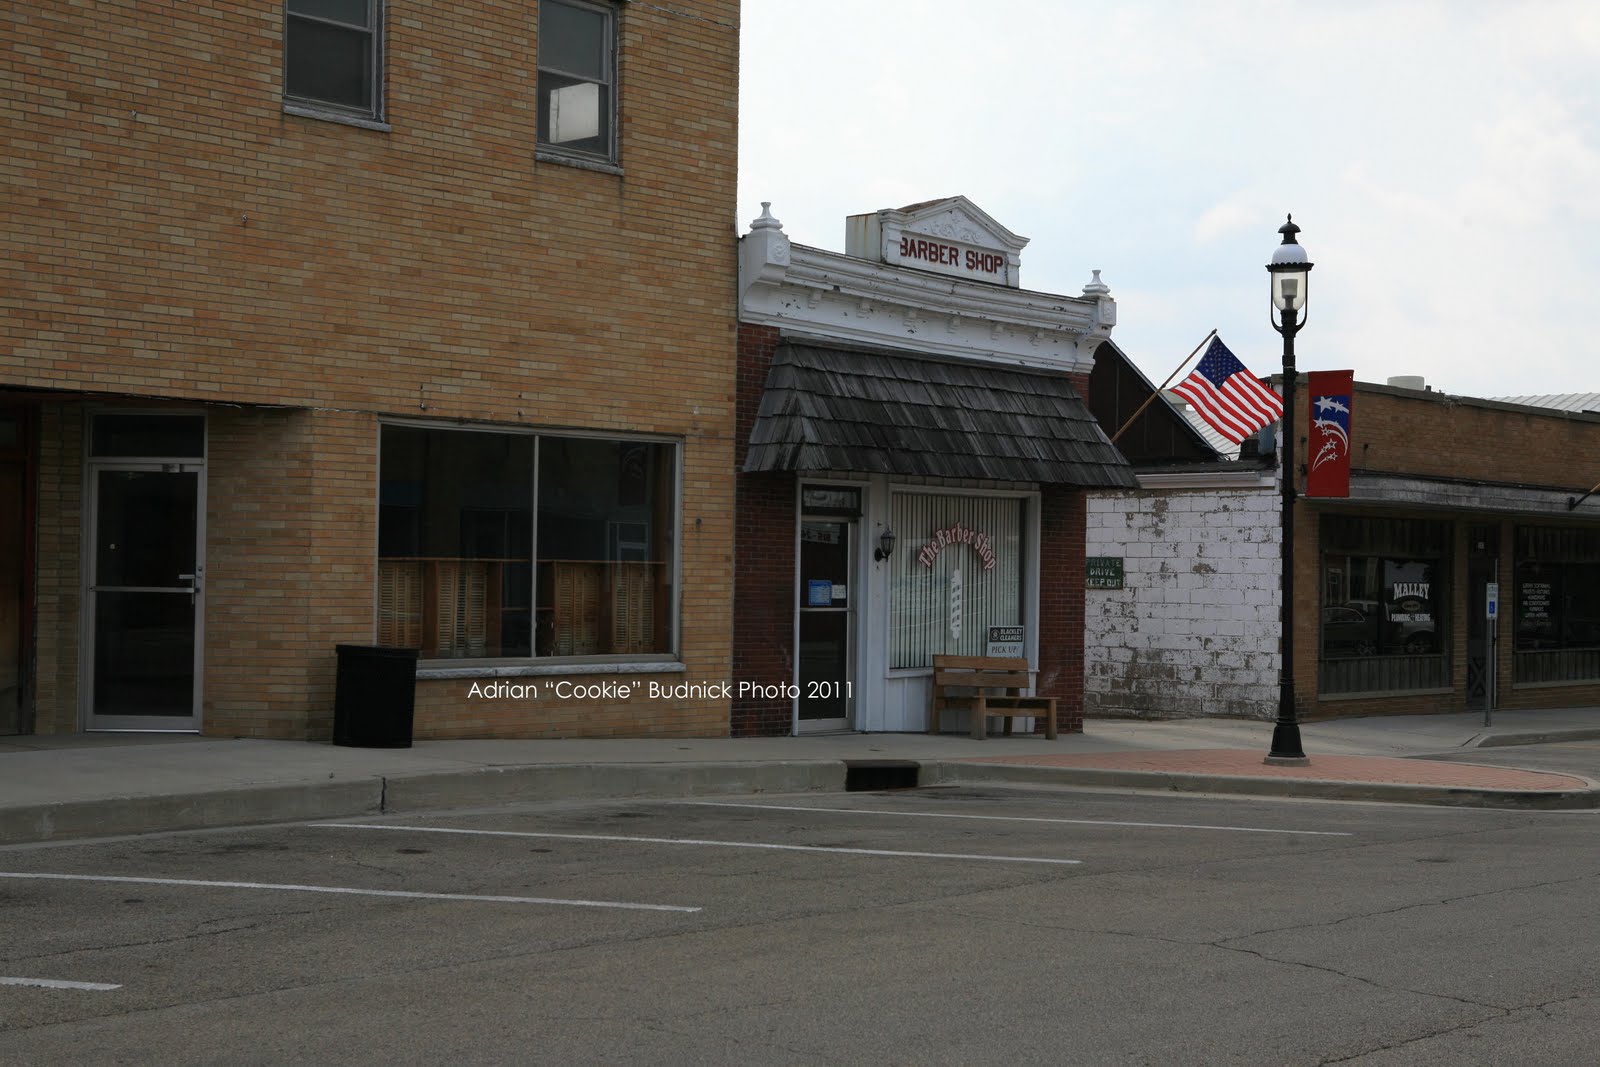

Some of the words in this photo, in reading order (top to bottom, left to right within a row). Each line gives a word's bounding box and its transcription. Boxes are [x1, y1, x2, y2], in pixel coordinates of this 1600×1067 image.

[899, 236, 959, 267] BARBER
[965, 250, 1004, 274] SHOP
[918, 538, 939, 568] The
[936, 522, 975, 549] Barber
[975, 533, 997, 570] Shop
[1090, 567, 1115, 576] DRIVE
[1106, 578, 1120, 587] OUT
[1393, 583, 1430, 600] MALLEY
